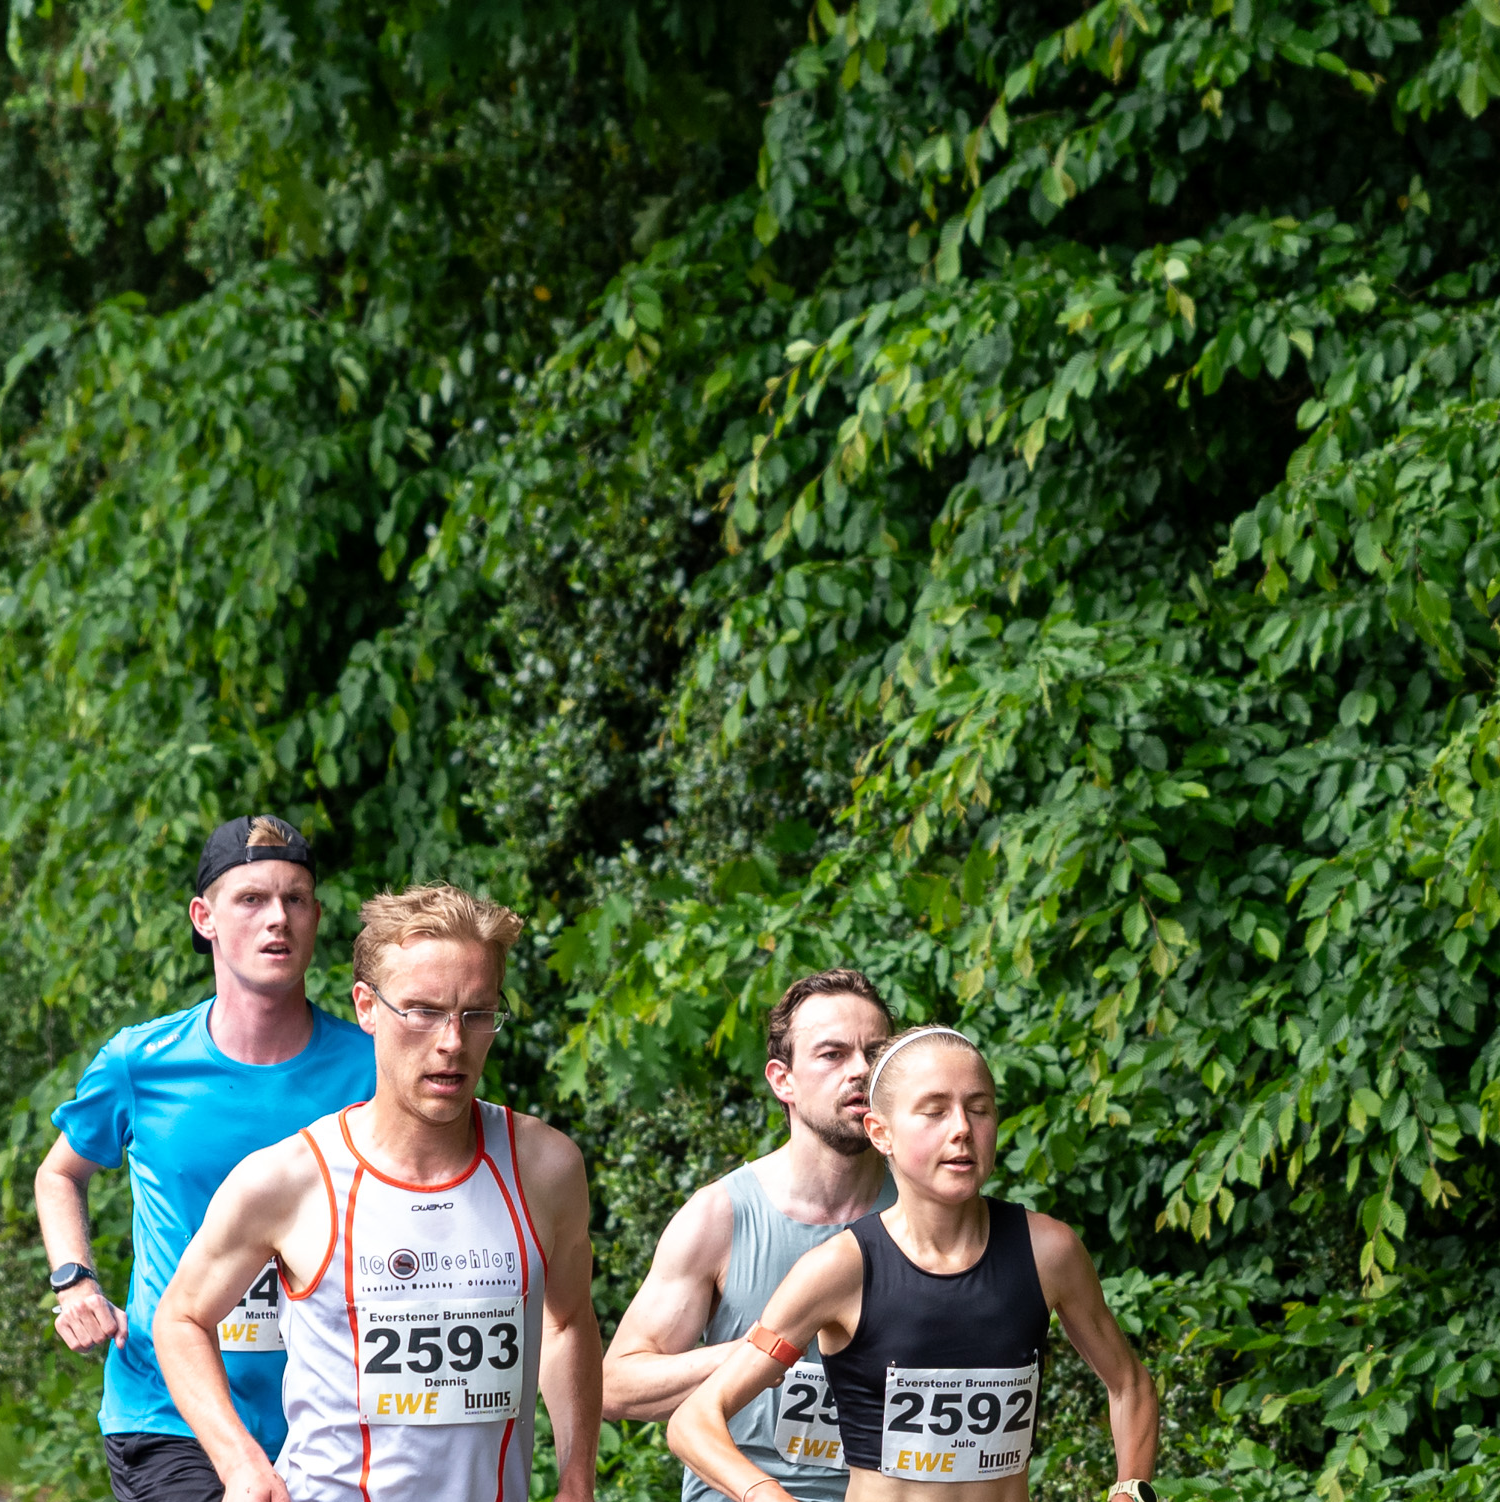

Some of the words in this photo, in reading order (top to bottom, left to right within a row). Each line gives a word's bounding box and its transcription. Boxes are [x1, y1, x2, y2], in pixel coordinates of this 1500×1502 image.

[422, 1249, 516, 1274] Wechloy
[245, 1310, 279, 1320] Matthi
[369, 1312, 440, 1322] Everstener
[443, 1307, 515, 1321] Brunnenlauf
[221, 1322, 259, 1342] WE
[364, 1322, 519, 1375] 2593
[424, 1376, 468, 1388] Dennis
[794, 1370, 825, 1382] Evers
[896, 1378, 962, 1388] Everstener
[965, 1375, 1033, 1388] Brunnenlauf
[376, 1391, 439, 1415] EWE
[464, 1388, 511, 1409] bruns
[781, 1383, 840, 1426] 25
[887, 1389, 1033, 1436] 2592
[786, 1435, 841, 1459] EWE
[950, 1439, 977, 1449] Jule
[896, 1450, 956, 1473] EWE
[978, 1449, 1022, 1469] bruns
